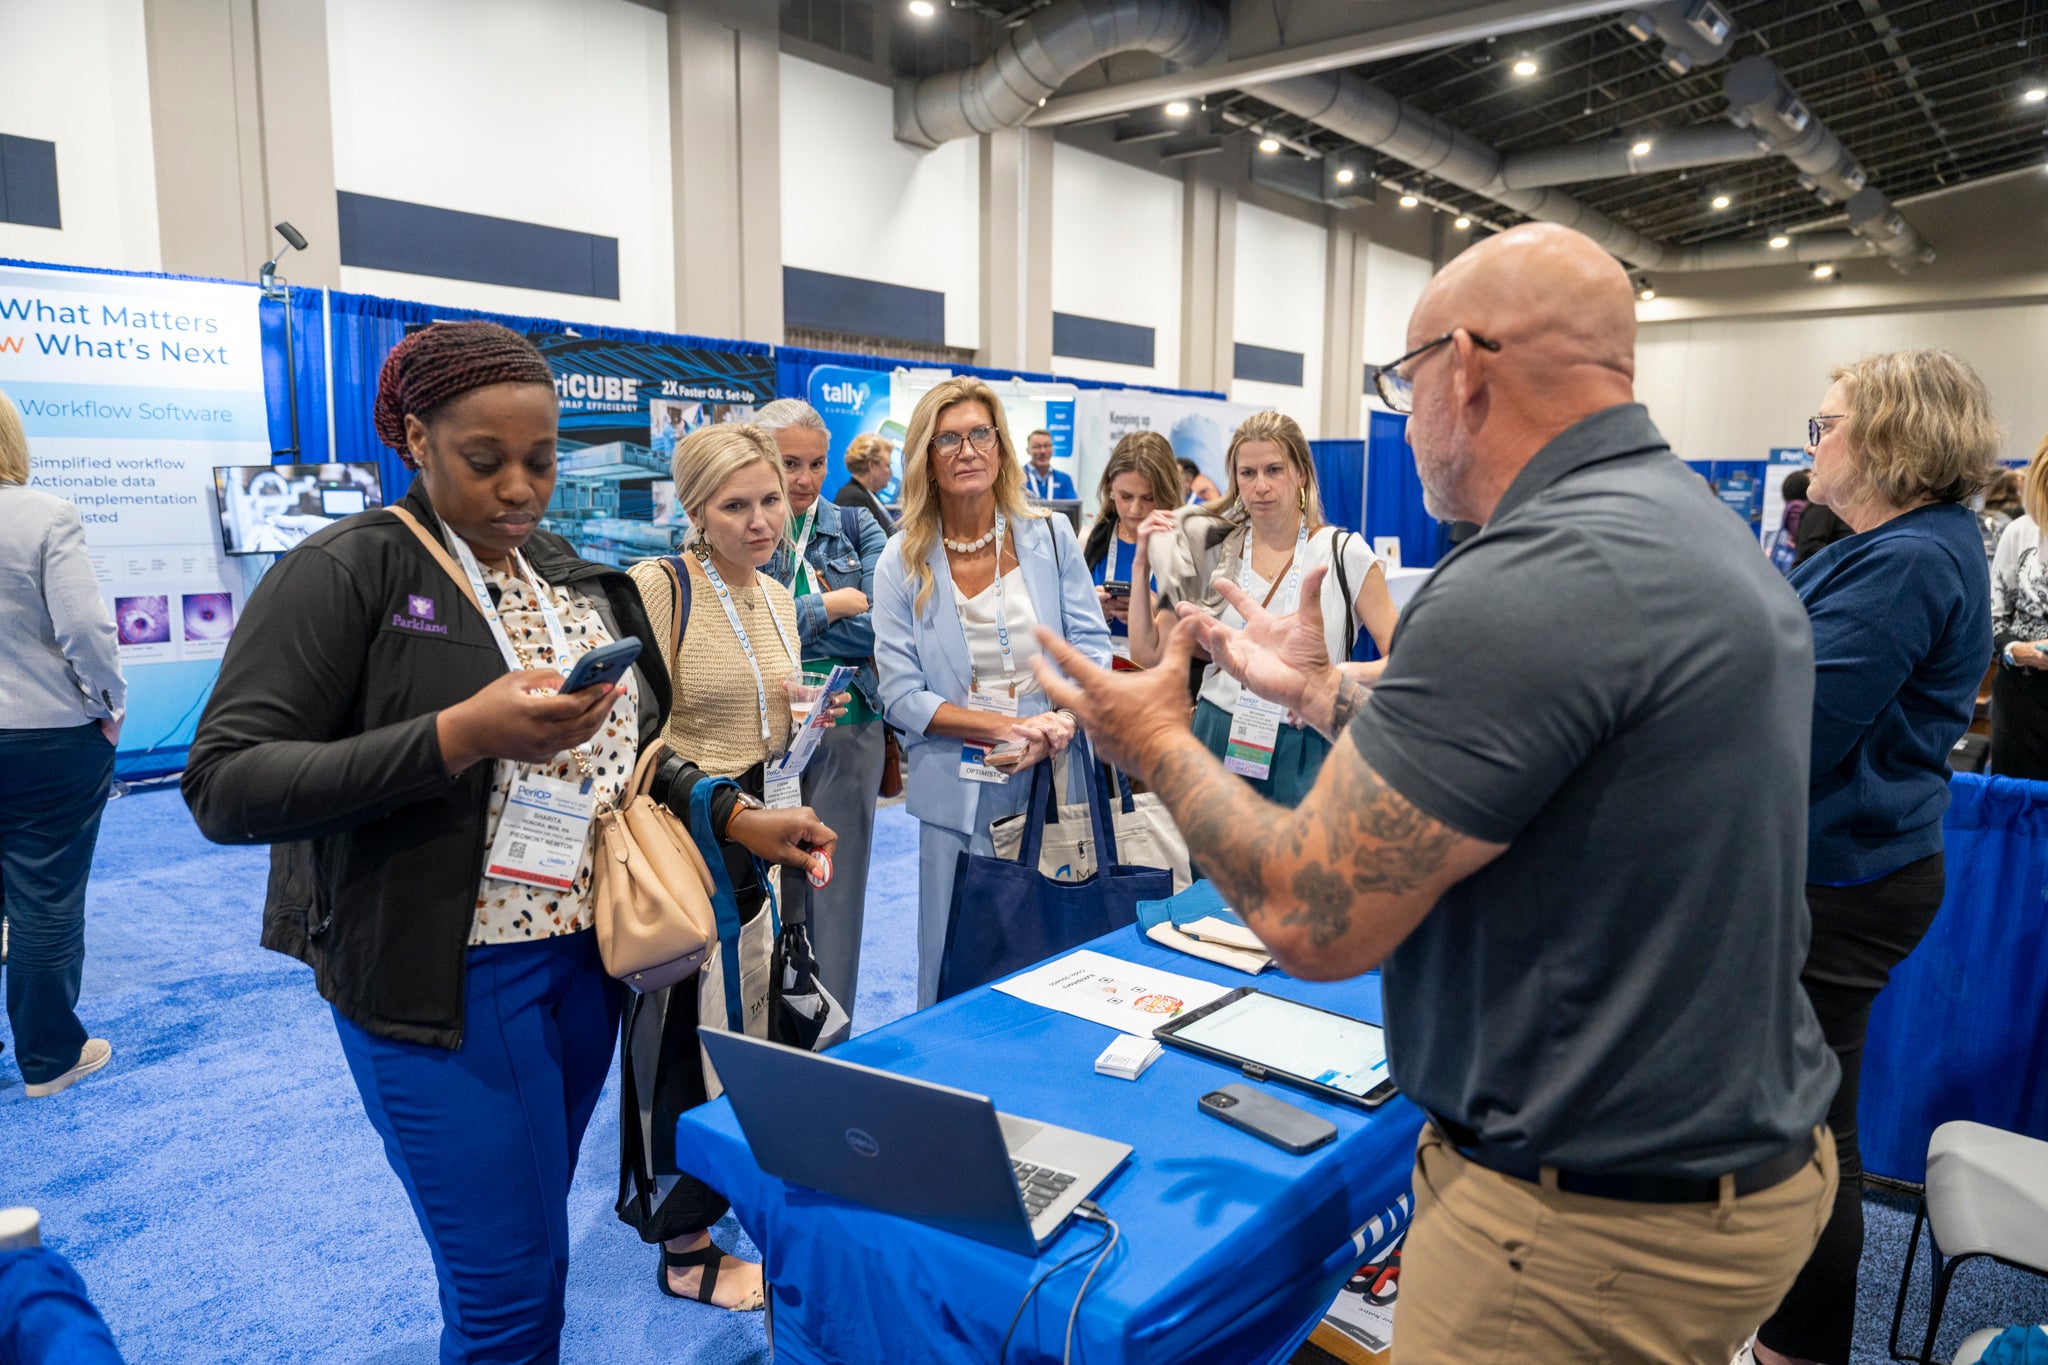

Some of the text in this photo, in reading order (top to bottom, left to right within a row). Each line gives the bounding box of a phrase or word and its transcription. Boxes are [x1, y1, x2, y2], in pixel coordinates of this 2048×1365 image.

[0, 298, 218, 334] What Matters
[35, 332, 151, 361] What's
[161, 340, 230, 365] Next
[661, 380, 755, 402] 2X Faster O.R. Set-Up
[821, 382, 864, 410] tally
[19, 399, 233, 423] Workflow Software
[586, 401, 638, 412] EFFICIENCY
[1109, 411, 1140, 428] Keeping
[31, 456, 185, 470] Simplified workflow
[31, 475, 156, 487] Actionable data
[74, 493, 197, 506] implementation
[392, 614, 448, 634] Parkland
[518, 785, 552, 799] PeriOP
[510, 831, 544, 843] PIEDMONT
[545, 840, 574, 850] NEWTON
